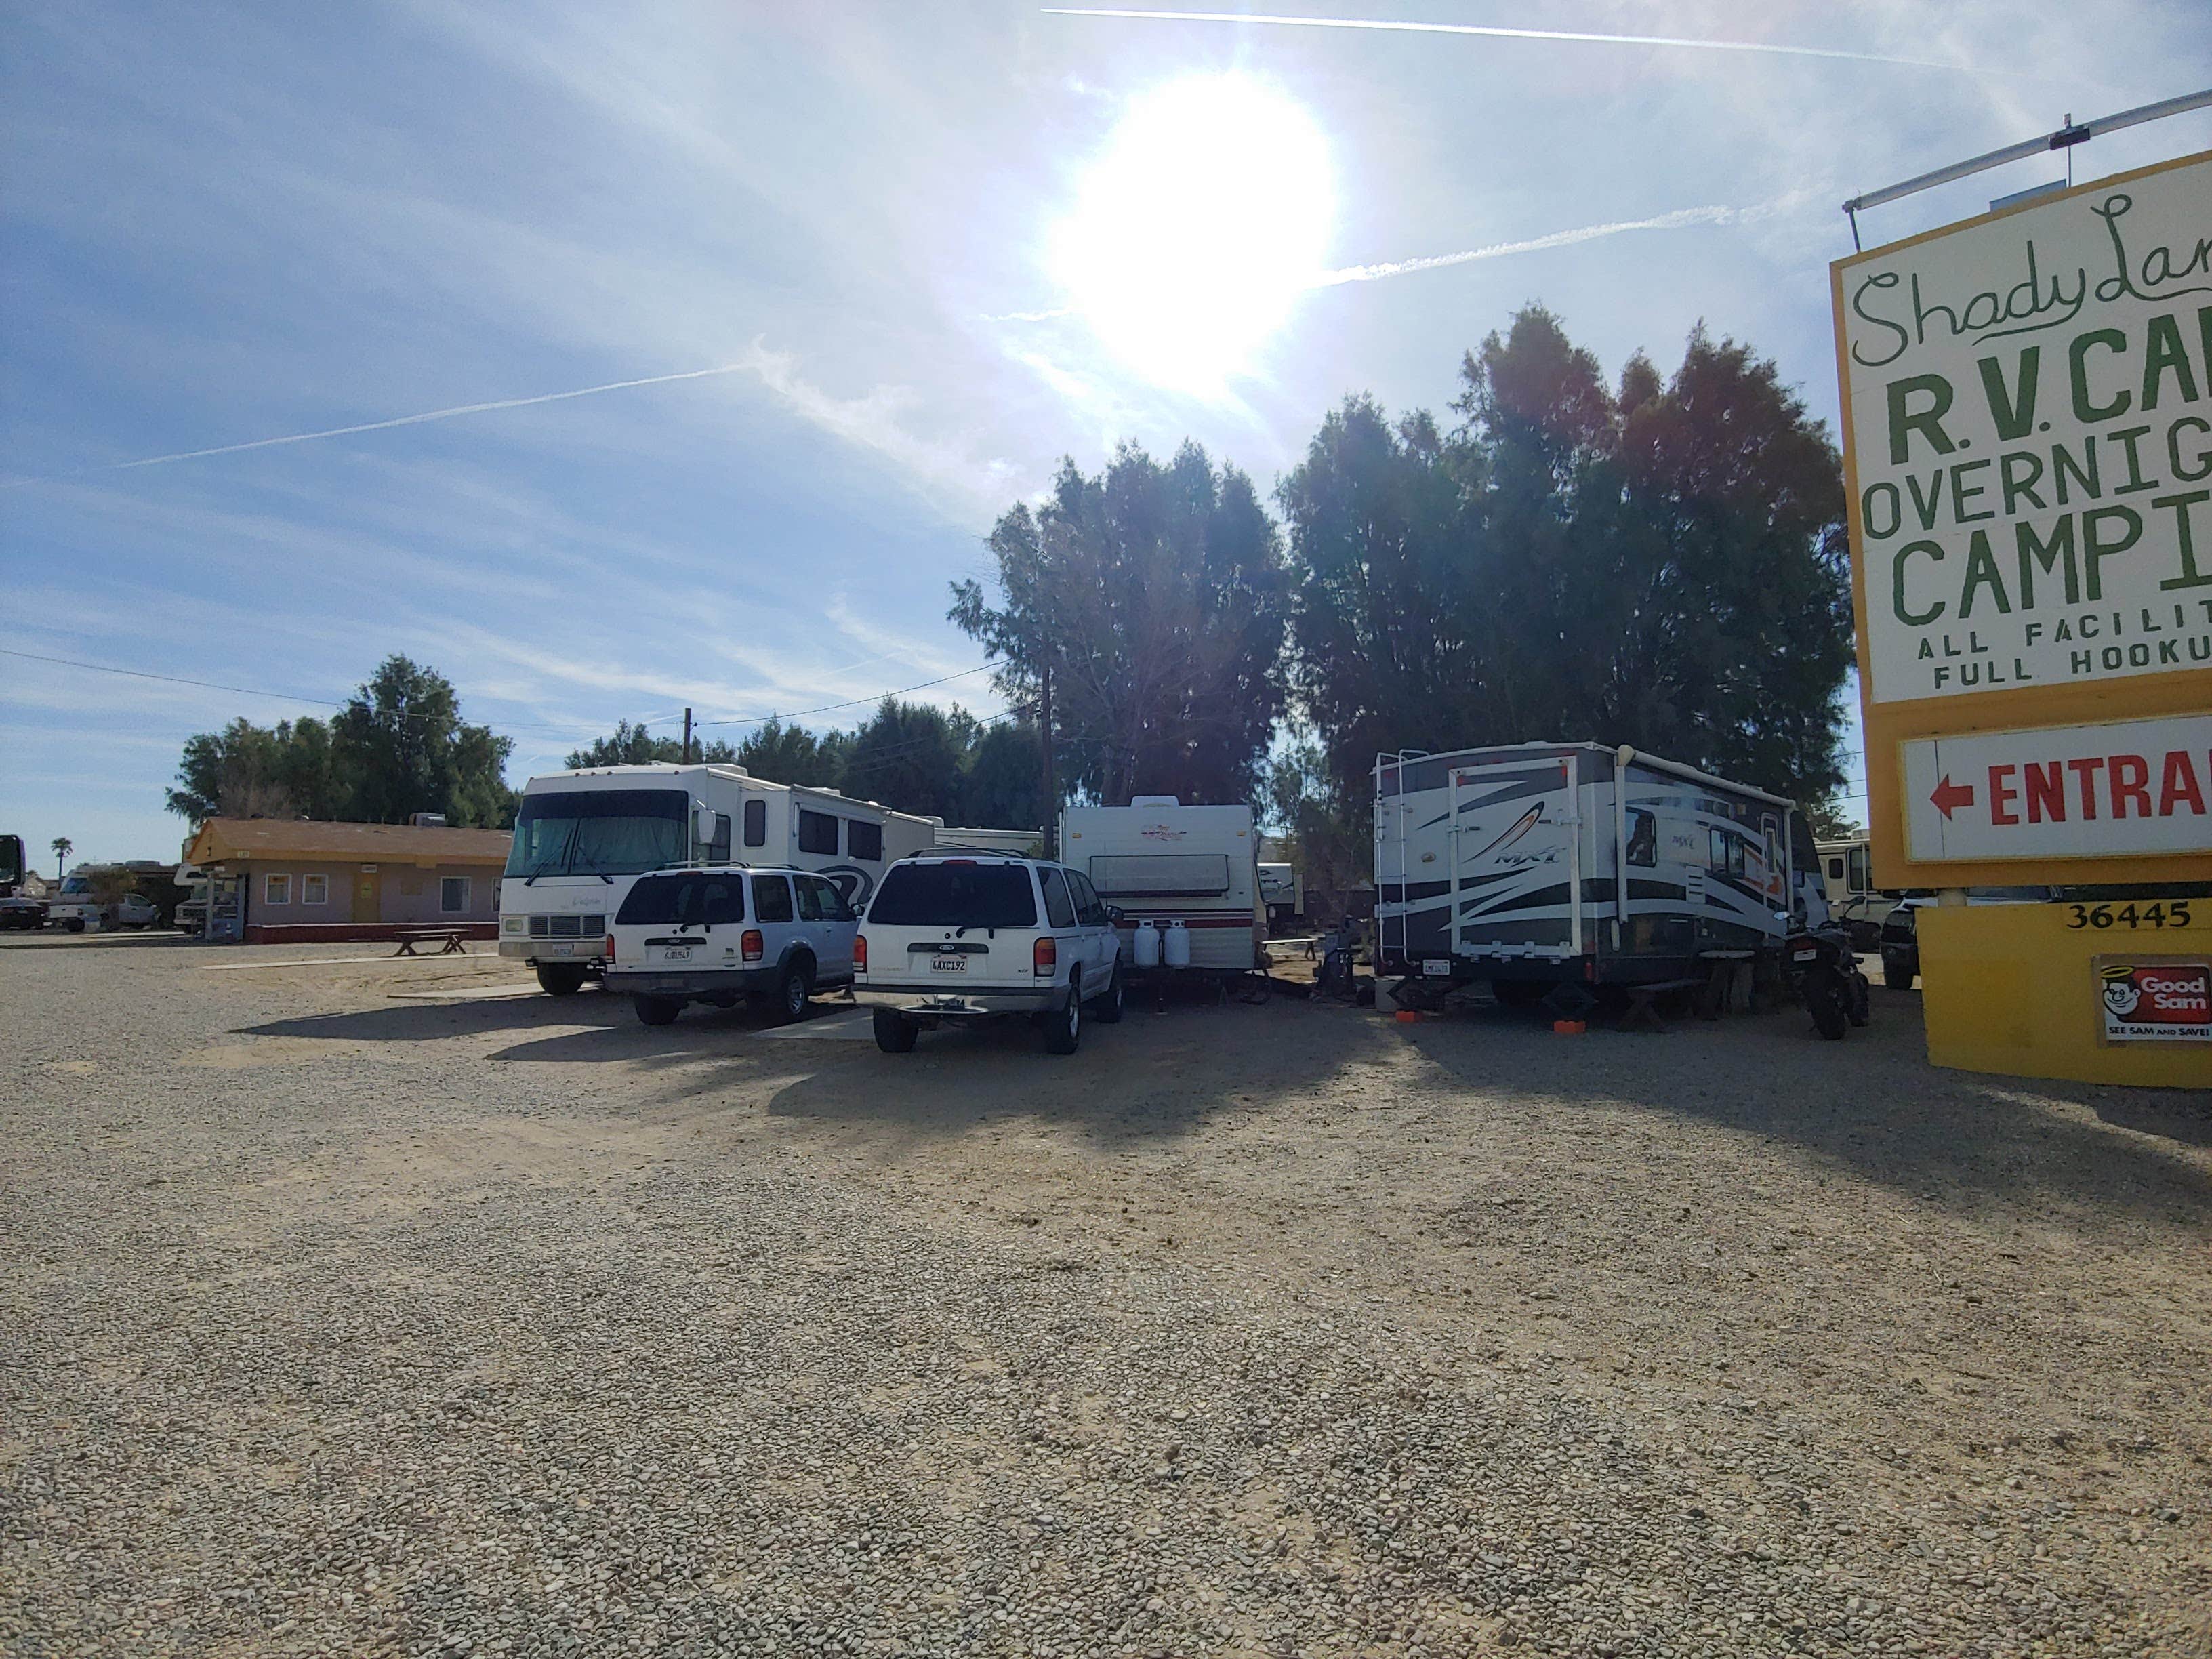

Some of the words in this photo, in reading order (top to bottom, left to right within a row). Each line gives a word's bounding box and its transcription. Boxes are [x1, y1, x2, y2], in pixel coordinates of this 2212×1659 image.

[1853, 240, 2086, 367] Shady
[1862, 417, 2212, 540] OVERNIG
[1893, 489, 2212, 627] CAMPI
[1918, 631, 1988, 660] ALL
[1934, 658, 2032, 689] FULL
[2070, 636, 2211, 674] HOOKU
[1988, 747, 2212, 826] ENTRA
[1492, 844, 1567, 868] MXT
[2066, 901, 2191, 929] 36445
[932, 961, 965, 970] 4AXC192
[2140, 976, 2205, 994] Good
[2153, 993, 2207, 1010] Sam
[2108, 1027, 2126, 1035] SEE
[2129, 1027, 2154, 1036] SAM
[2178, 1028, 2210, 1036] SAVE!
